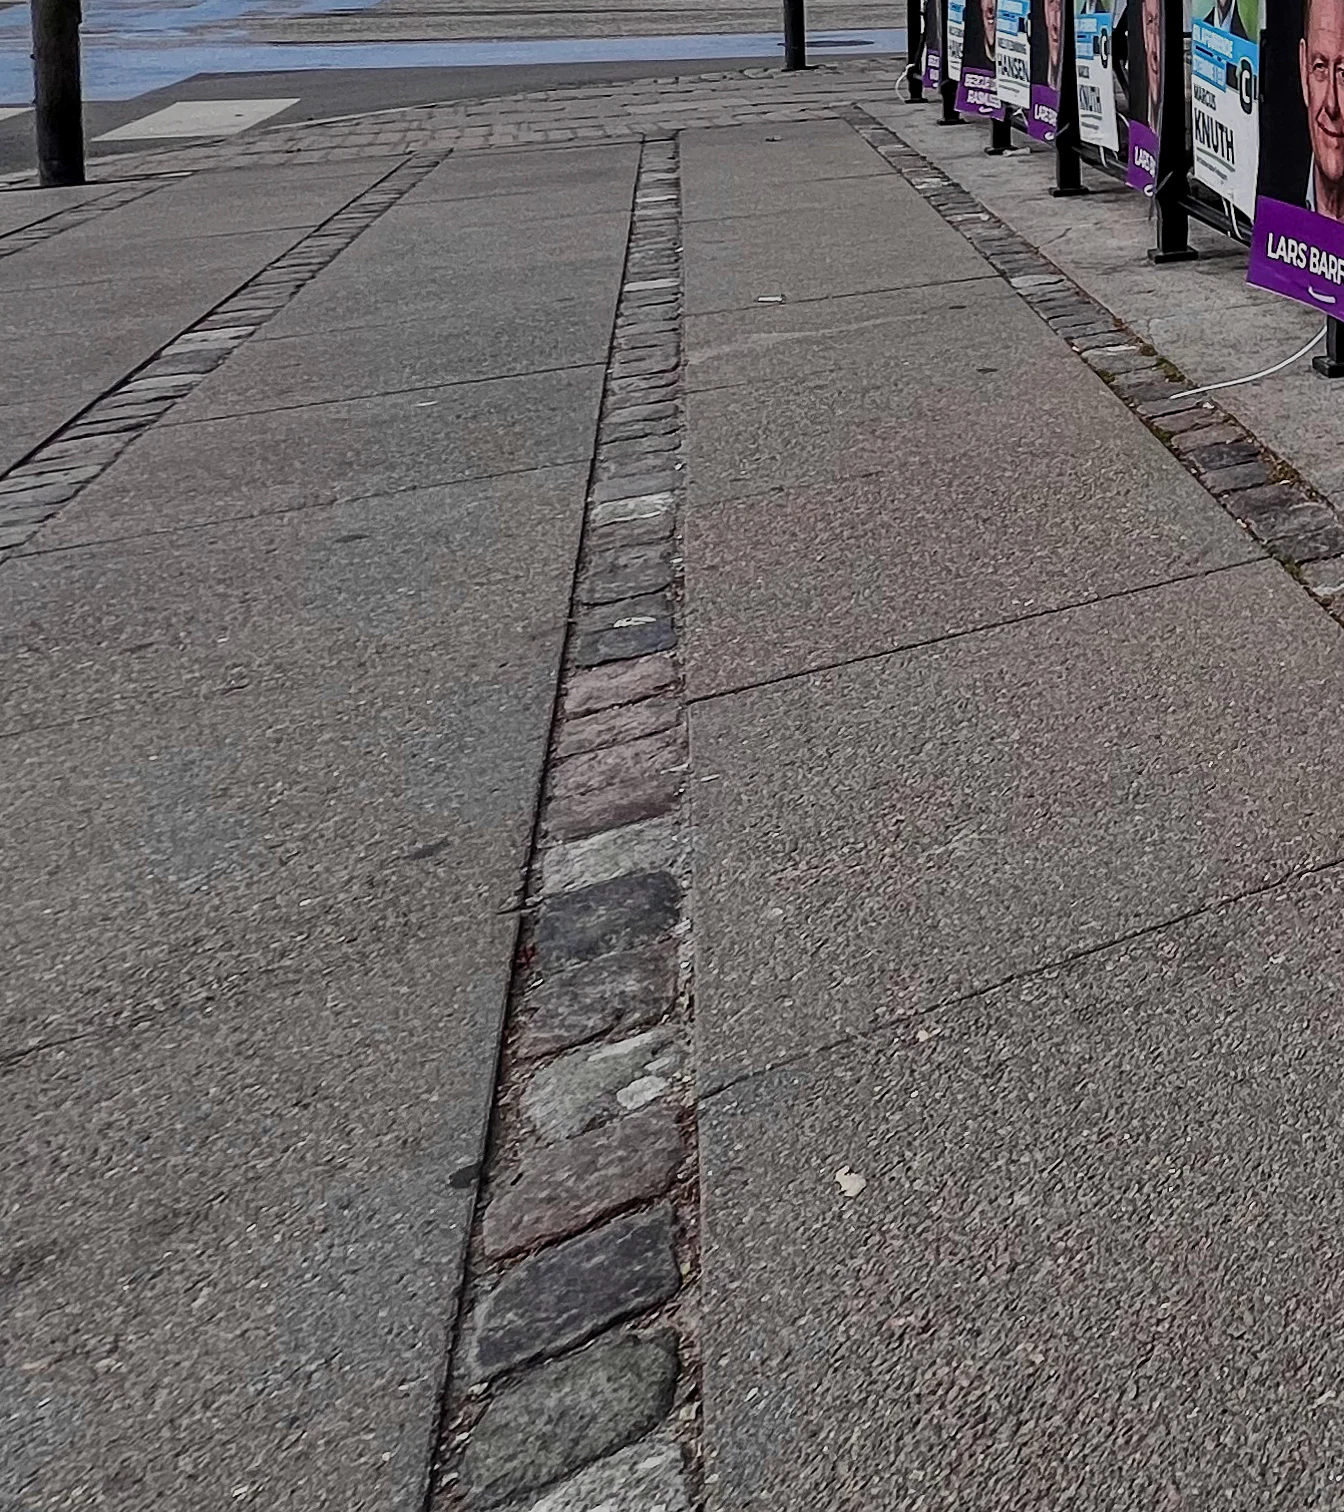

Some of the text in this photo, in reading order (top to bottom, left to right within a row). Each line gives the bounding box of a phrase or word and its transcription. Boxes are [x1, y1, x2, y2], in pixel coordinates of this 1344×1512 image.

[1241, 69, 1250, 104] C
[1195, 107, 1234, 164] KNUTH
[1267, 231, 1306, 270] LARS
